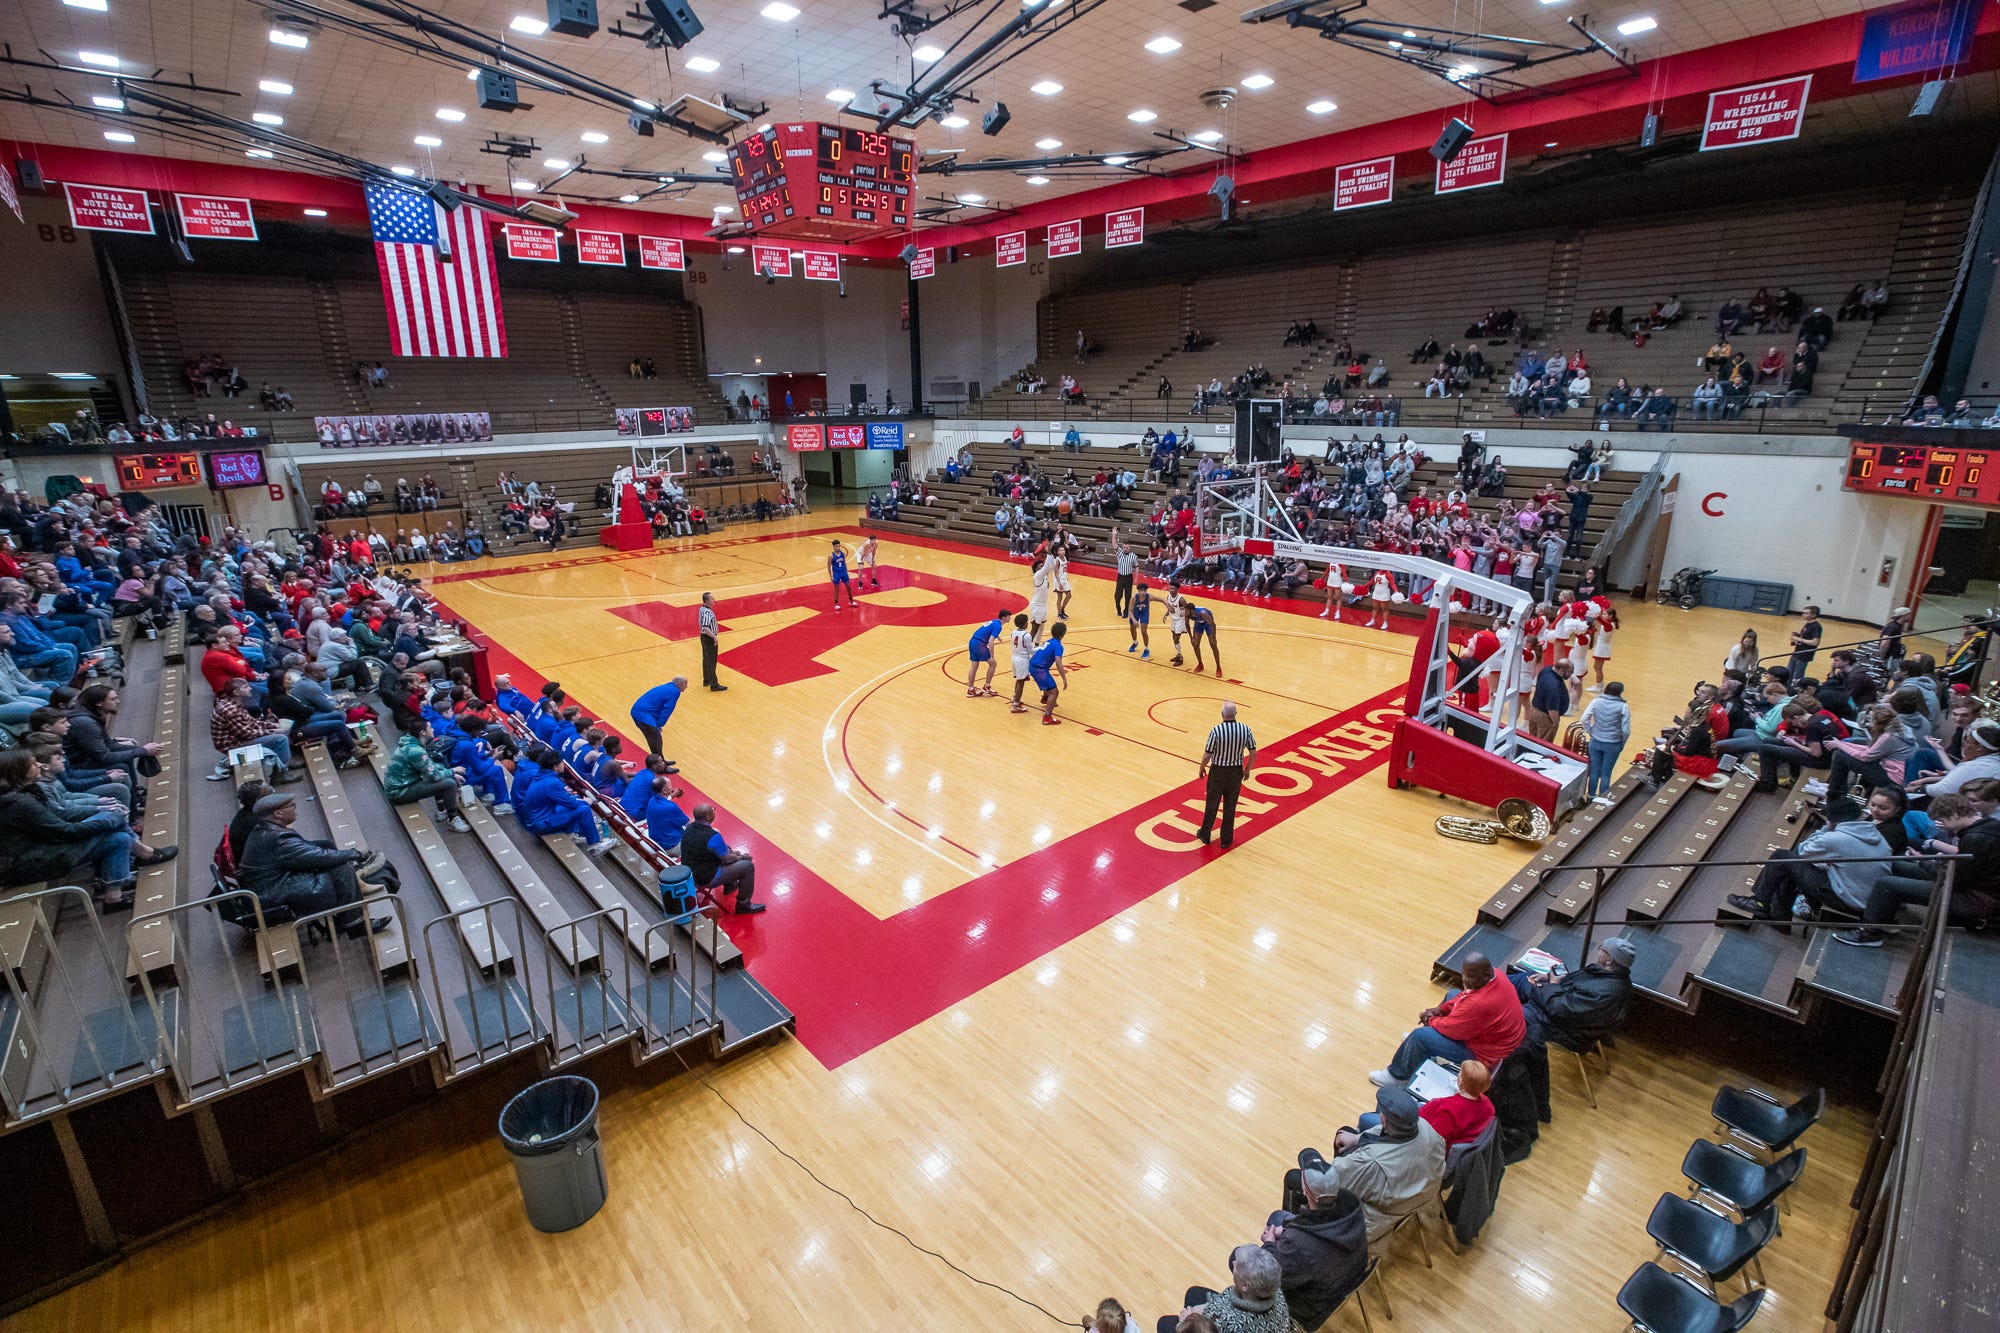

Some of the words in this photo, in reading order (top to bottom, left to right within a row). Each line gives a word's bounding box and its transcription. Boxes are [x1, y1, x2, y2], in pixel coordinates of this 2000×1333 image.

[1879, 39, 1949, 70] WILDCATS
[1738, 90, 1777, 105] IHSAA
[1723, 99, 1788, 118] WRESTLING
[1709, 118, 1738, 131] STATE
[1741, 110, 1798, 128] RUNNER-UP
[1737, 127, 1761, 139] 1959
[822, 126, 839, 138] Home
[856, 131, 887, 156] 7:25
[892, 140, 911, 151] Guests
[772, 140, 781, 160] 0
[786, 149, 812, 157] RICHMOND
[831, 140, 841, 161] 0
[1457, 145, 1485, 157] IHSAA
[902, 153, 911, 172] 0
[1468, 152, 1497, 165] COUNTRY
[735, 158, 744, 177] 0
[766, 162, 771, 175] 1
[856, 165, 875, 176] period
[883, 166, 887, 179] 1
[1353, 166, 1375, 177] IHSAA
[1444, 168, 1464, 178] STATE
[1466, 161, 1496, 174] FINALIST
[855, 178, 875, 190] player
[1340, 178, 1355, 188] BOYS
[1357, 172, 1389, 185] SWIMMING
[1441, 179, 1456, 187] 1995
[1339, 186, 1358, 196] STATE
[1358, 181, 1388, 193] FINALIST
[91, 191, 123, 202] IHSAA
[823, 187, 831, 202] 0
[840, 189, 847, 204] 5
[881, 195, 888, 210] 5
[902, 199, 906, 212] 1
[1339, 195, 1352, 204] 1994
[83, 199, 107, 209] BOYS
[111, 202, 135, 212] GOLF
[200, 201, 229, 211] IHSAA
[743, 203, 750, 217] 0
[750, 201, 757, 214] 5
[772, 192, 780, 206] 5
[785, 189, 789, 201] 1
[76, 207, 106, 218] STATE
[109, 210, 146, 221] CHAMPS
[192, 208, 241, 219] WRESTLING
[856, 211, 871, 220] game
[894, 215, 906, 224] won
[103, 217, 124, 227] 1941
[184, 216, 209, 226] STATE
[210, 218, 252, 228] CO-CHAMPS
[1113, 220, 1135, 230] BASEBALL
[37, 223, 77, 243] BB
[522, 229, 542, 237] IHSAA
[1121, 226, 1141, 235] FINALIST
[523, 235, 556, 244] BASKETBALL
[591, 234, 610, 242] IHSAA
[513, 241, 531, 249] STATE
[532, 243, 553, 251] CHAMPS
[582, 246, 598, 254] STATE
[598, 247, 620, 255] CHAMPS
[601, 241, 615, 249] GOLF
[527, 249, 542, 257] 1992
[645, 254, 661, 262] STATE
[661, 256, 680, 264] CHAMPS
[660, 250, 681, 258] COUNTRY
[1029, 262, 1044, 275] CC
[689, 271, 707, 284] BB
[645, 412, 663, 421] 7:25
[881, 425, 898, 435] Reid
[1931, 452, 1957, 463] Guests
[132, 466, 144, 481] 0
[189, 462, 199, 475] 0
[221, 463, 237, 473] Red
[1861, 459, 1873, 478] 0
[1939, 465, 1954, 486] 0
[1968, 468, 1979, 483] 0
[218, 473, 245, 484] Devils
[1884, 479, 1907, 488] period
[269, 484, 285, 501] B
[1701, 492, 1728, 517] C
[1277, 542, 1302, 552] SPALDING
[1313, 547, 1382, 562] www.richmondreddevils.com
[1330, 564, 1337, 573] R
[1374, 576, 1383, 584] R
[1013, 635, 1019, 648] 4
